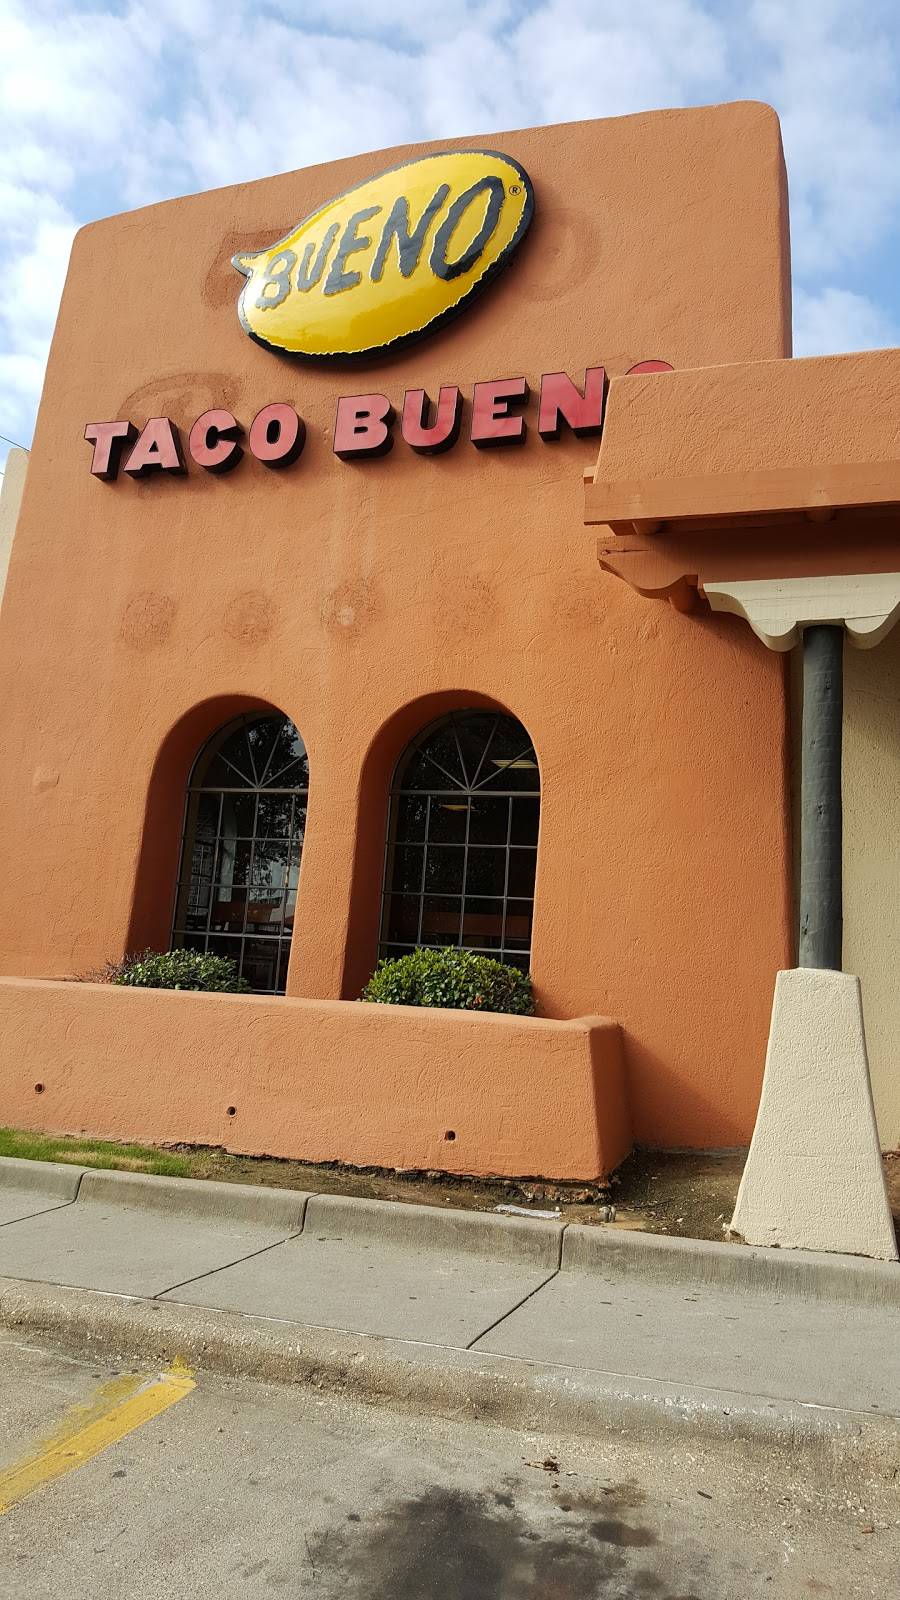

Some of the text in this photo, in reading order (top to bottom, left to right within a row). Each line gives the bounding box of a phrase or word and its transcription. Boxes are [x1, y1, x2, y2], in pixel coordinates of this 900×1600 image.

[254, 175, 506, 311] BUENO
[84, 360, 676, 480] TACO BUEN
